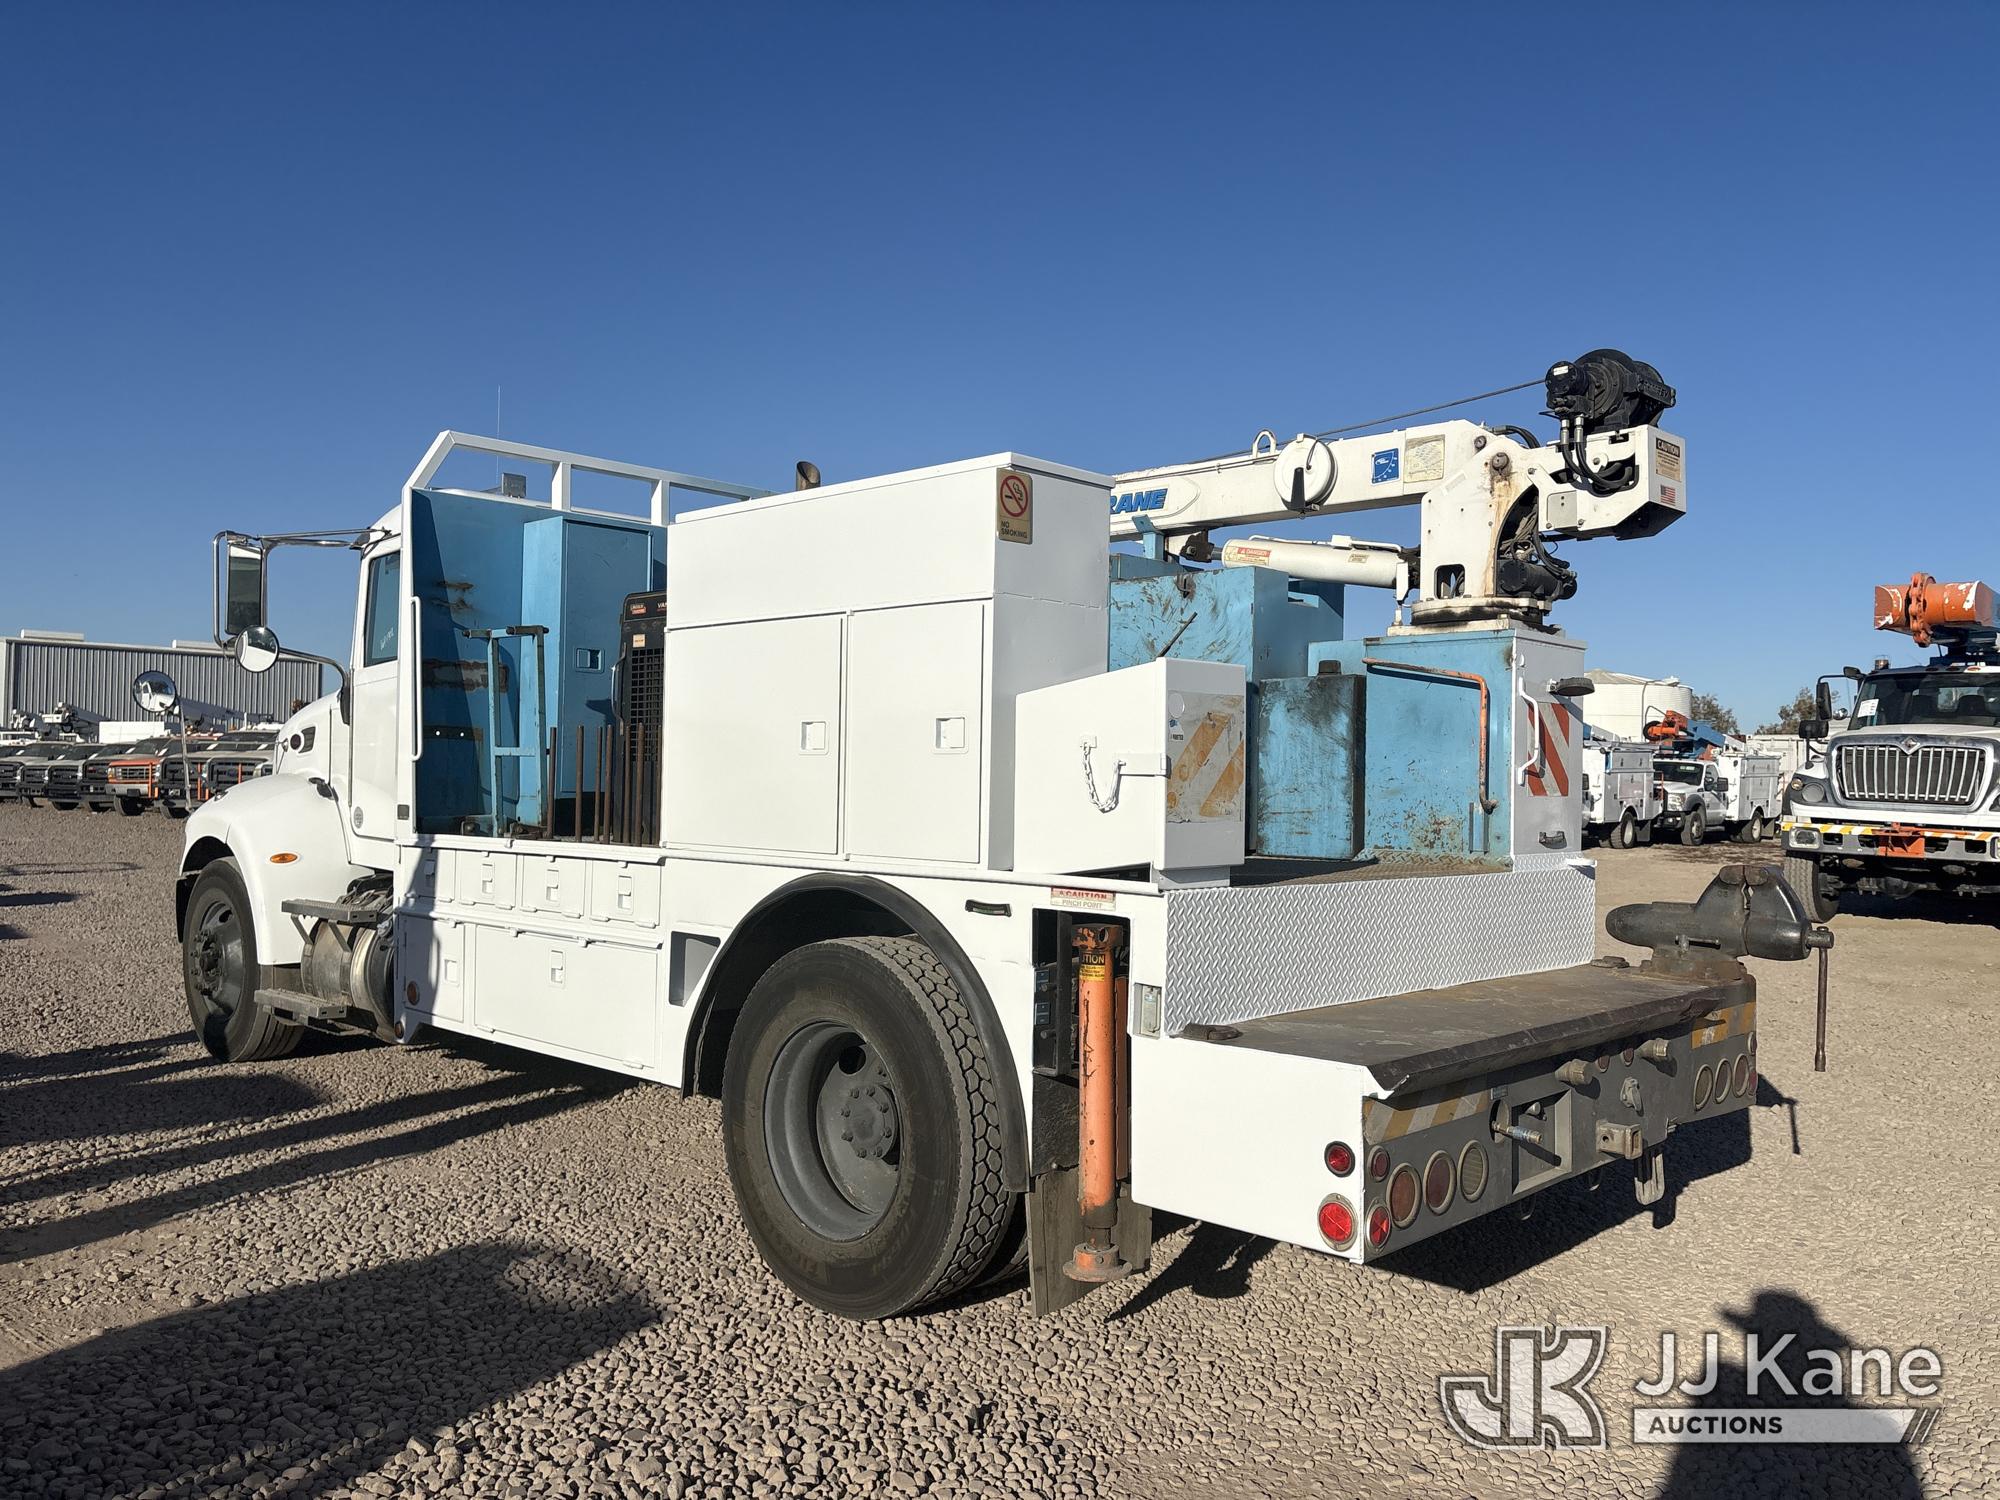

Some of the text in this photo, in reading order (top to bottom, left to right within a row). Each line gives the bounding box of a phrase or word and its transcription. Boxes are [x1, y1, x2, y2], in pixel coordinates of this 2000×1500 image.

[1657, 440, 1679, 457] CAUTION
[1001, 528, 1027, 538] SMOKING
[1065, 890, 1107, 899] CAUTION
[1062, 899, 1103, 909] PINCH POINT
